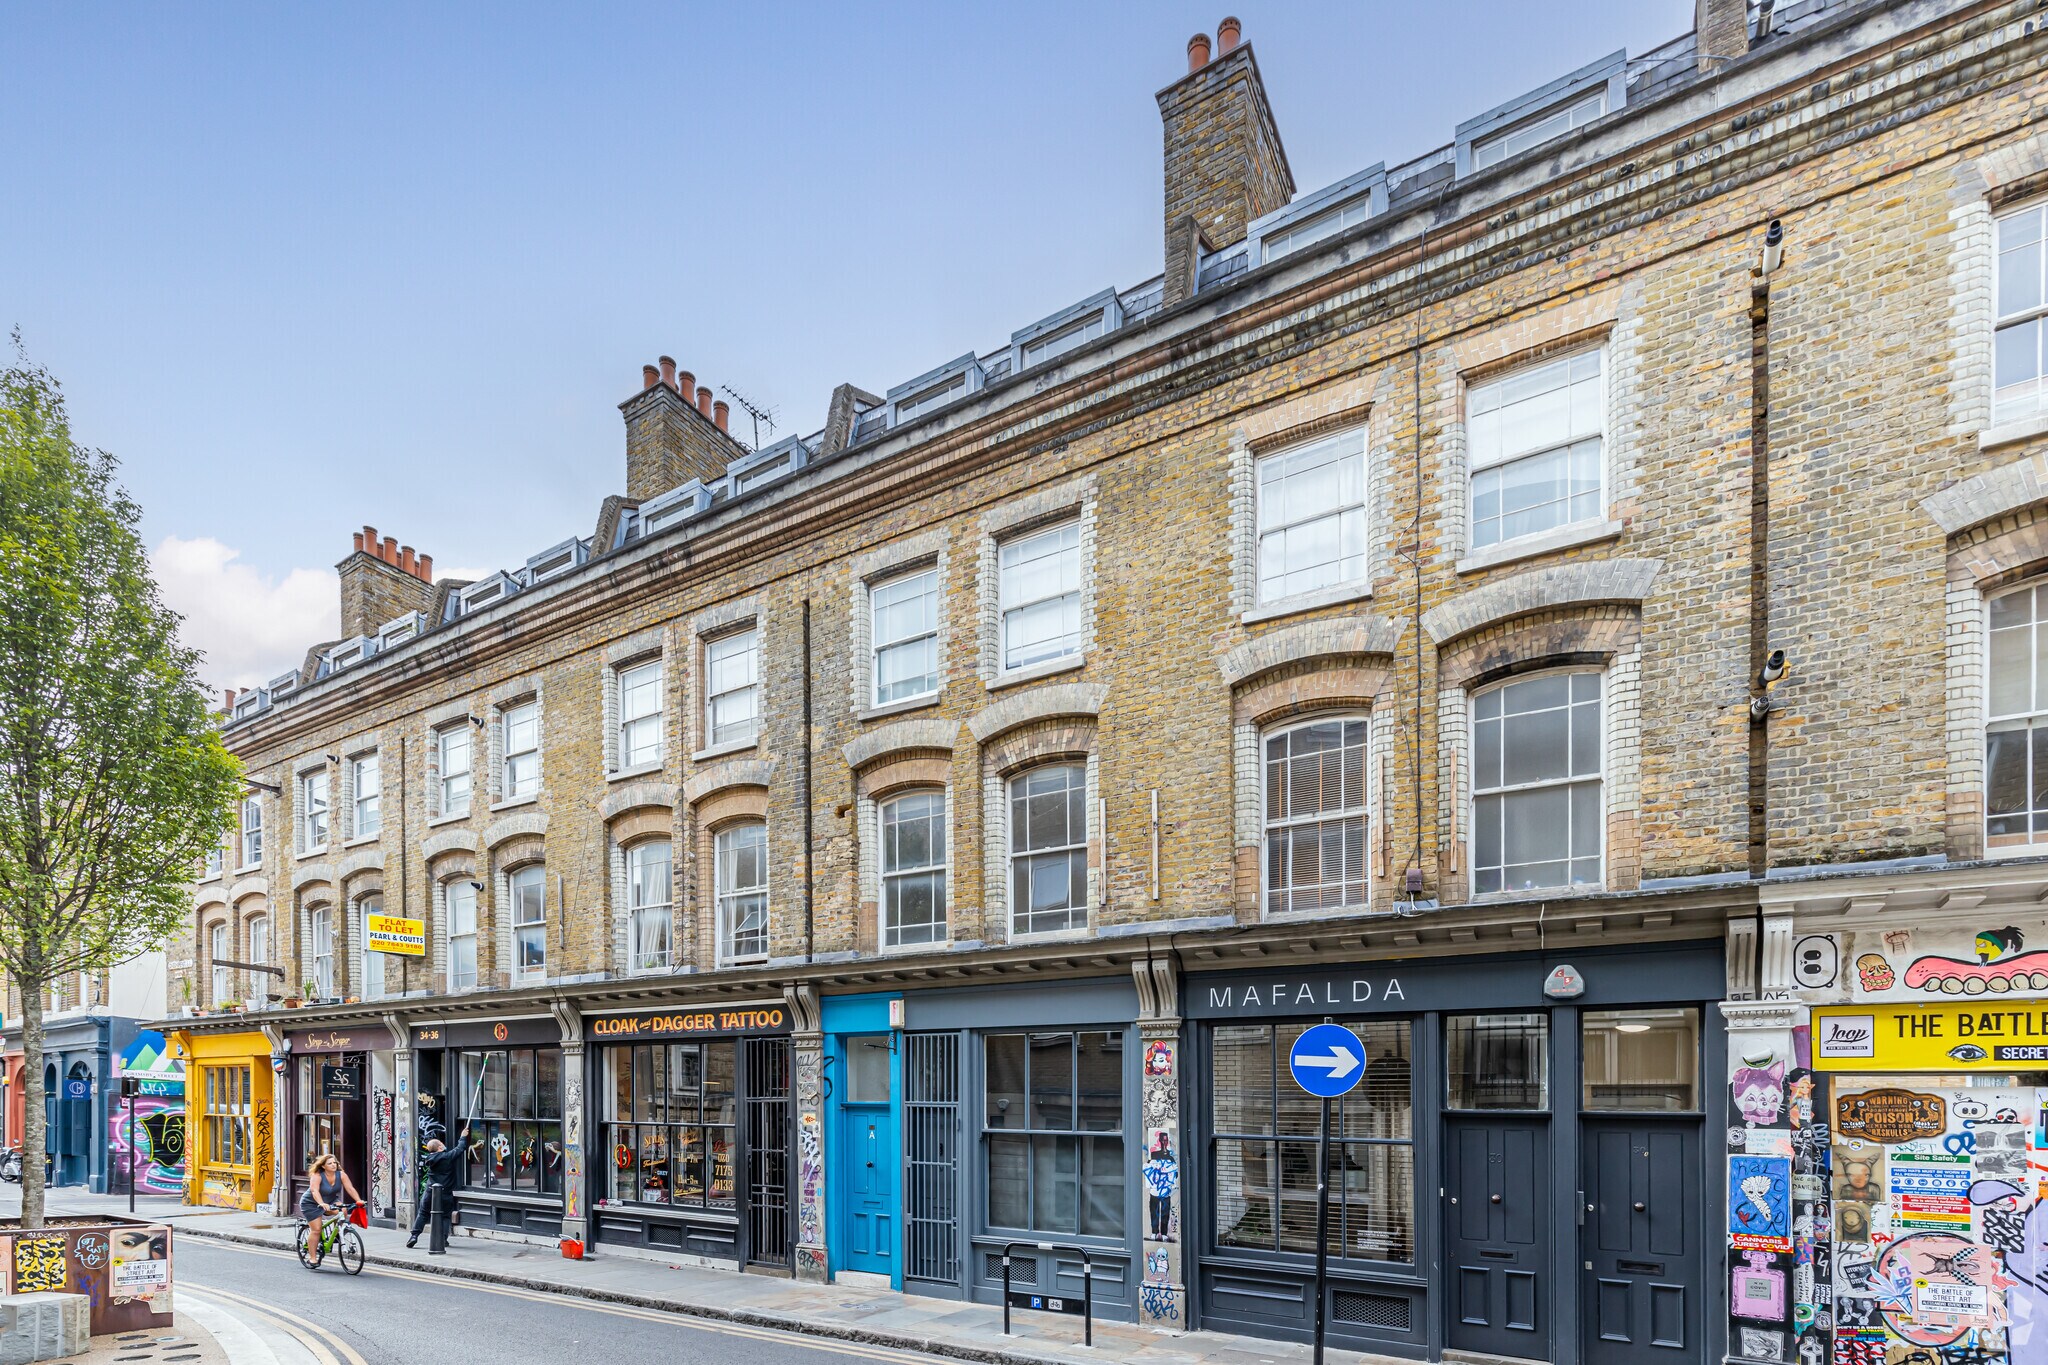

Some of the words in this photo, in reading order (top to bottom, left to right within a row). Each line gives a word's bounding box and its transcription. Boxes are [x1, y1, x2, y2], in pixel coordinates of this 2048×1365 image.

[400, 935, 424, 943] COUTTS
[1209, 978, 1405, 1008] MAFALDA
[594, 1018, 640, 1036] CLOAK
[652, 1014, 717, 1034] DAGGER
[720, 1010, 783, 1030] TATTOO
[1894, 1014, 1944, 1038] THE
[1869, 1096, 1908, 1105] WARNING
[1865, 1112, 1914, 1123] POISON
[869, 1131, 875, 1140] A
[715, 1165, 733, 1176] 7175
[714, 1179, 733, 1191] 0133
[1736, 1236, 1782, 1244] CANNABIS
[1033, 1297, 1041, 1307] P
